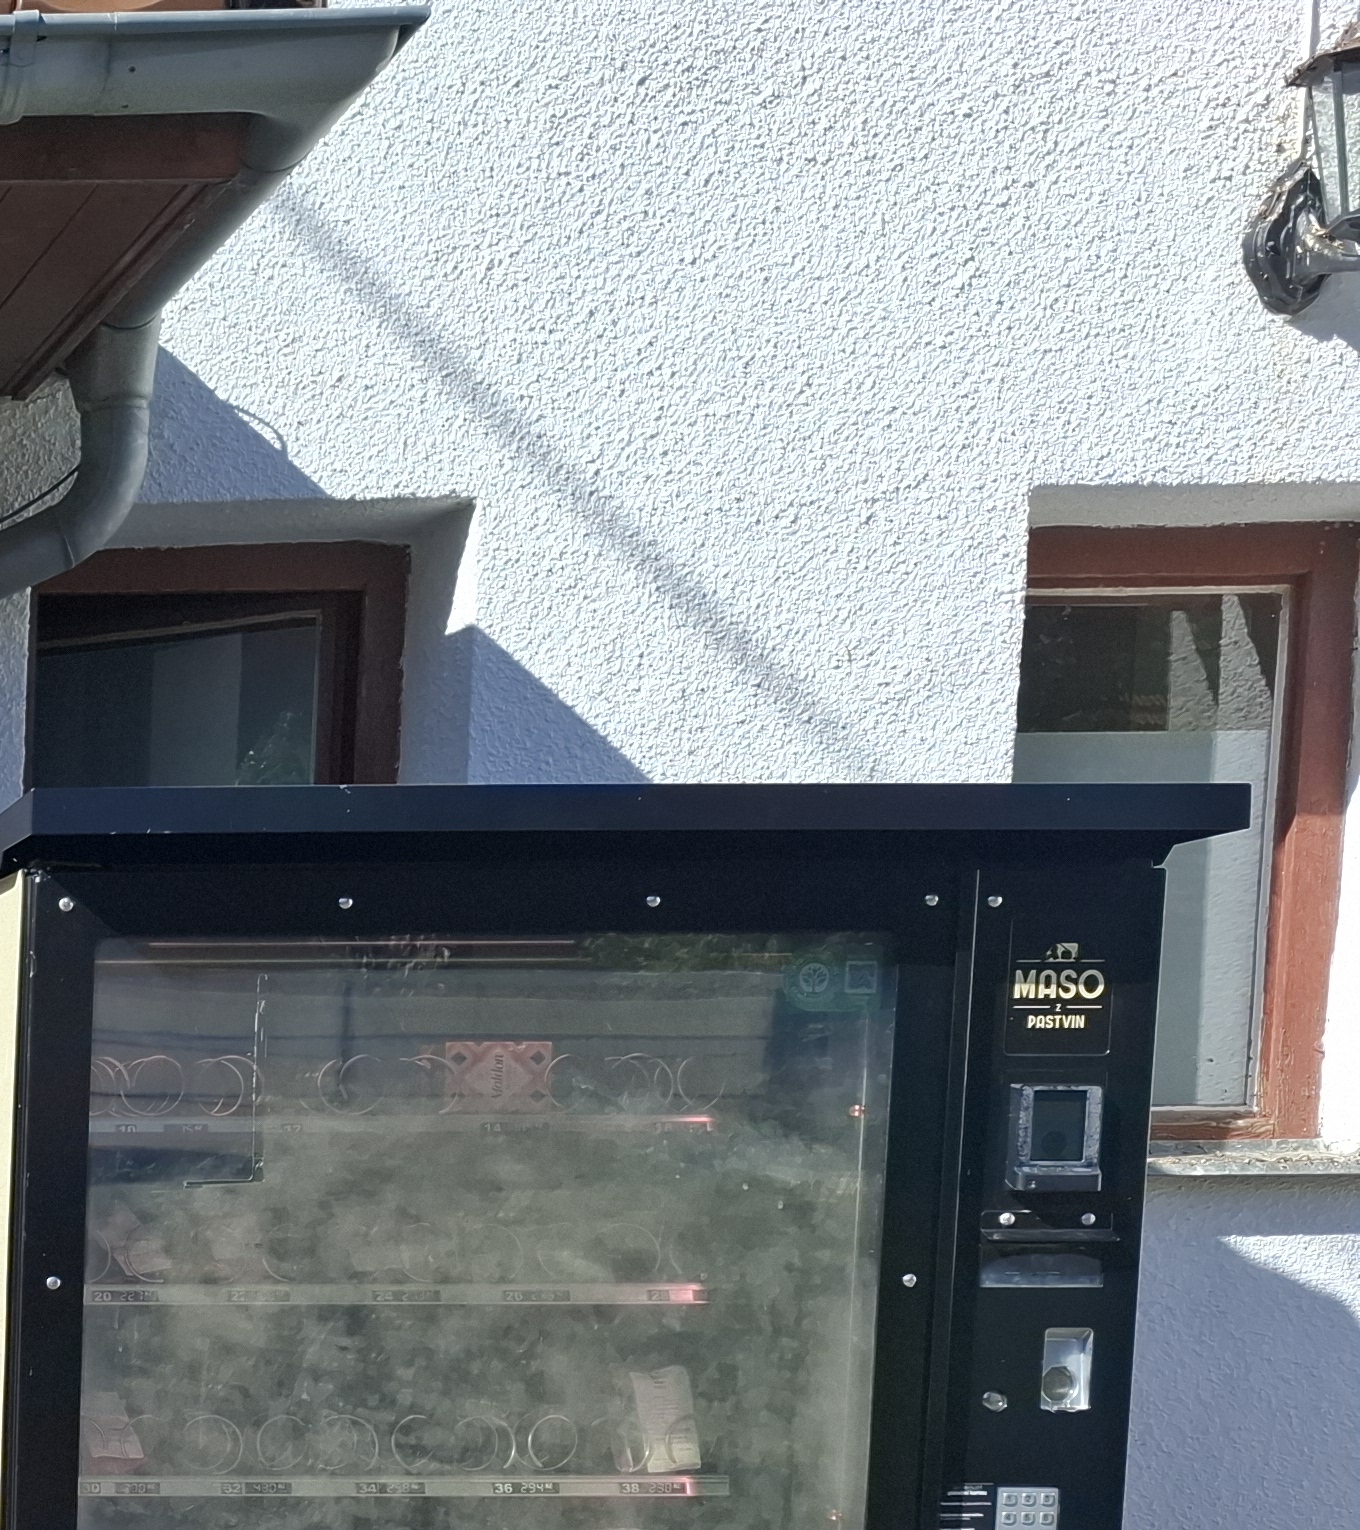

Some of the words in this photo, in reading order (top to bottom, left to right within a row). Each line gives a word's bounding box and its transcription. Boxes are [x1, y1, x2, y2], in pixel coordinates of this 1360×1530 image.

[1013, 969, 1105, 999] MASO
[1027, 1014, 1086, 1029] PASTVIN
[93, 1291, 112, 1302] 20
[375, 1291, 393, 1301] 24
[223, 1484, 241, 1493] 32
[359, 1484, 377, 1493] 34
[494, 1484, 513, 1494] 36
[521, 1484, 544, 1494] 294
[622, 1484, 640, 1494] 38
